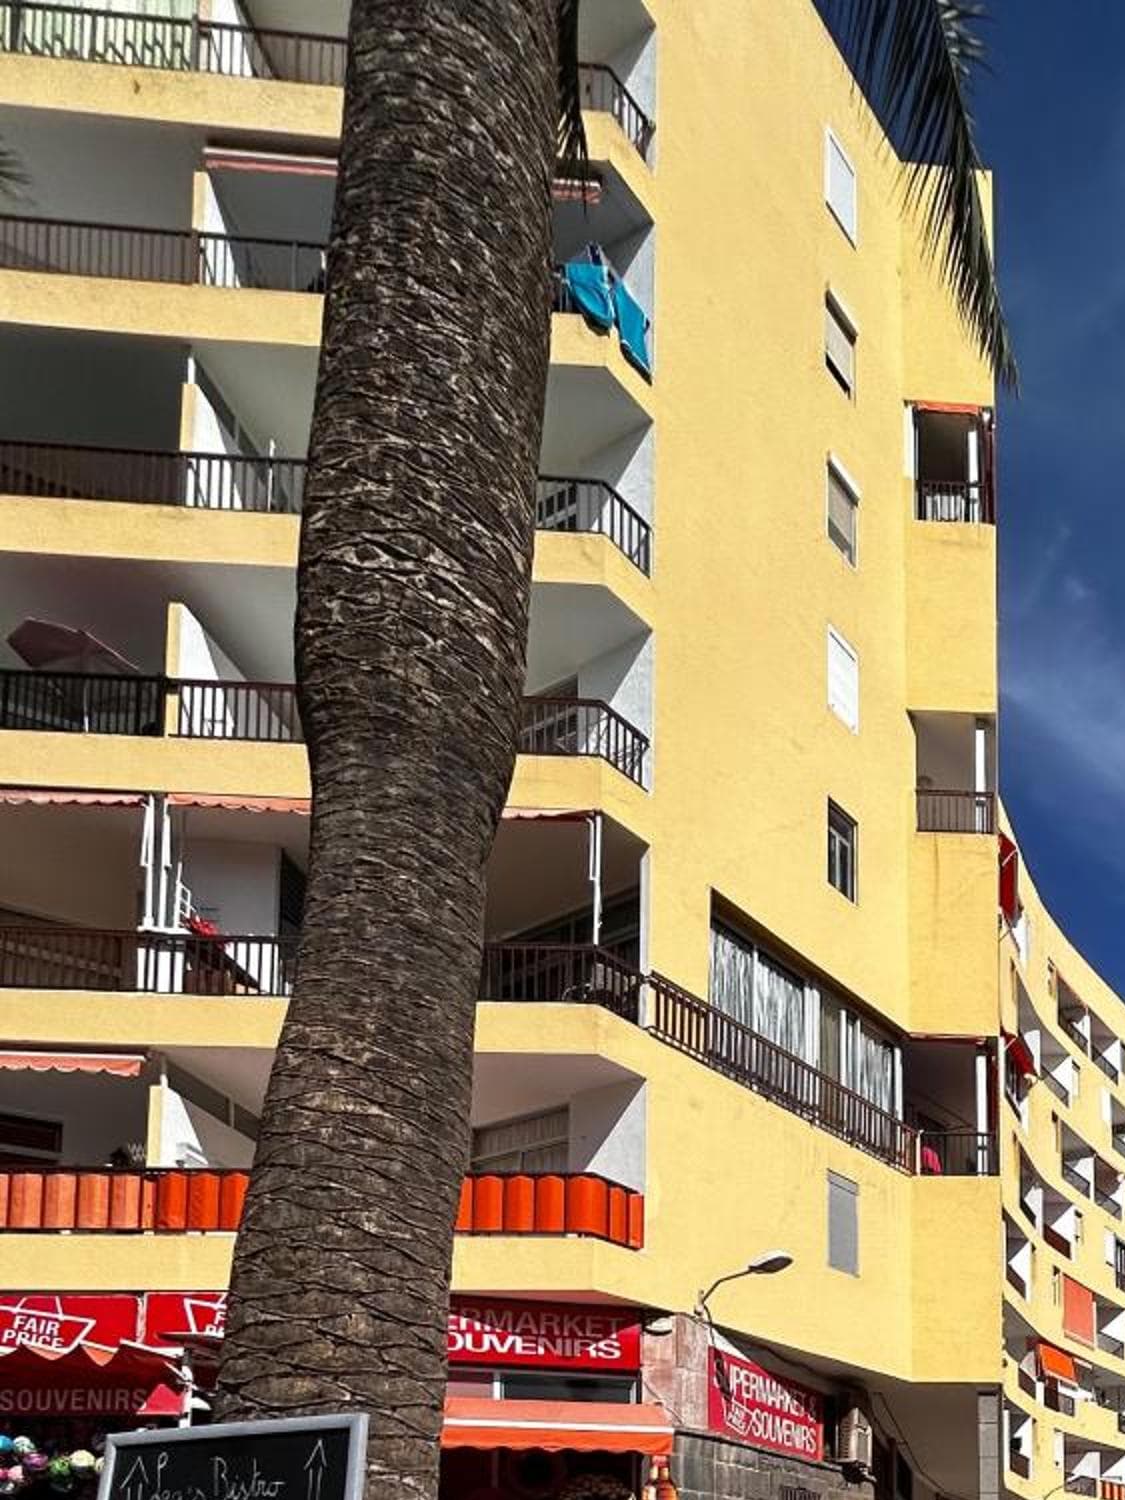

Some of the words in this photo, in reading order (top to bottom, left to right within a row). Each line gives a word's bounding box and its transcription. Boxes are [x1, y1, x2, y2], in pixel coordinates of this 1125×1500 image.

[12, 1314, 61, 1337] FAIR
[448, 1306, 625, 1339] ERMARKET
[1, 1329, 65, 1350] PRICE
[448, 1331, 622, 1360] OUVENIRS
[0, 1386, 148, 1412] SOUVENIRS
[751, 1408, 817, 1454] SOUVENIRS
